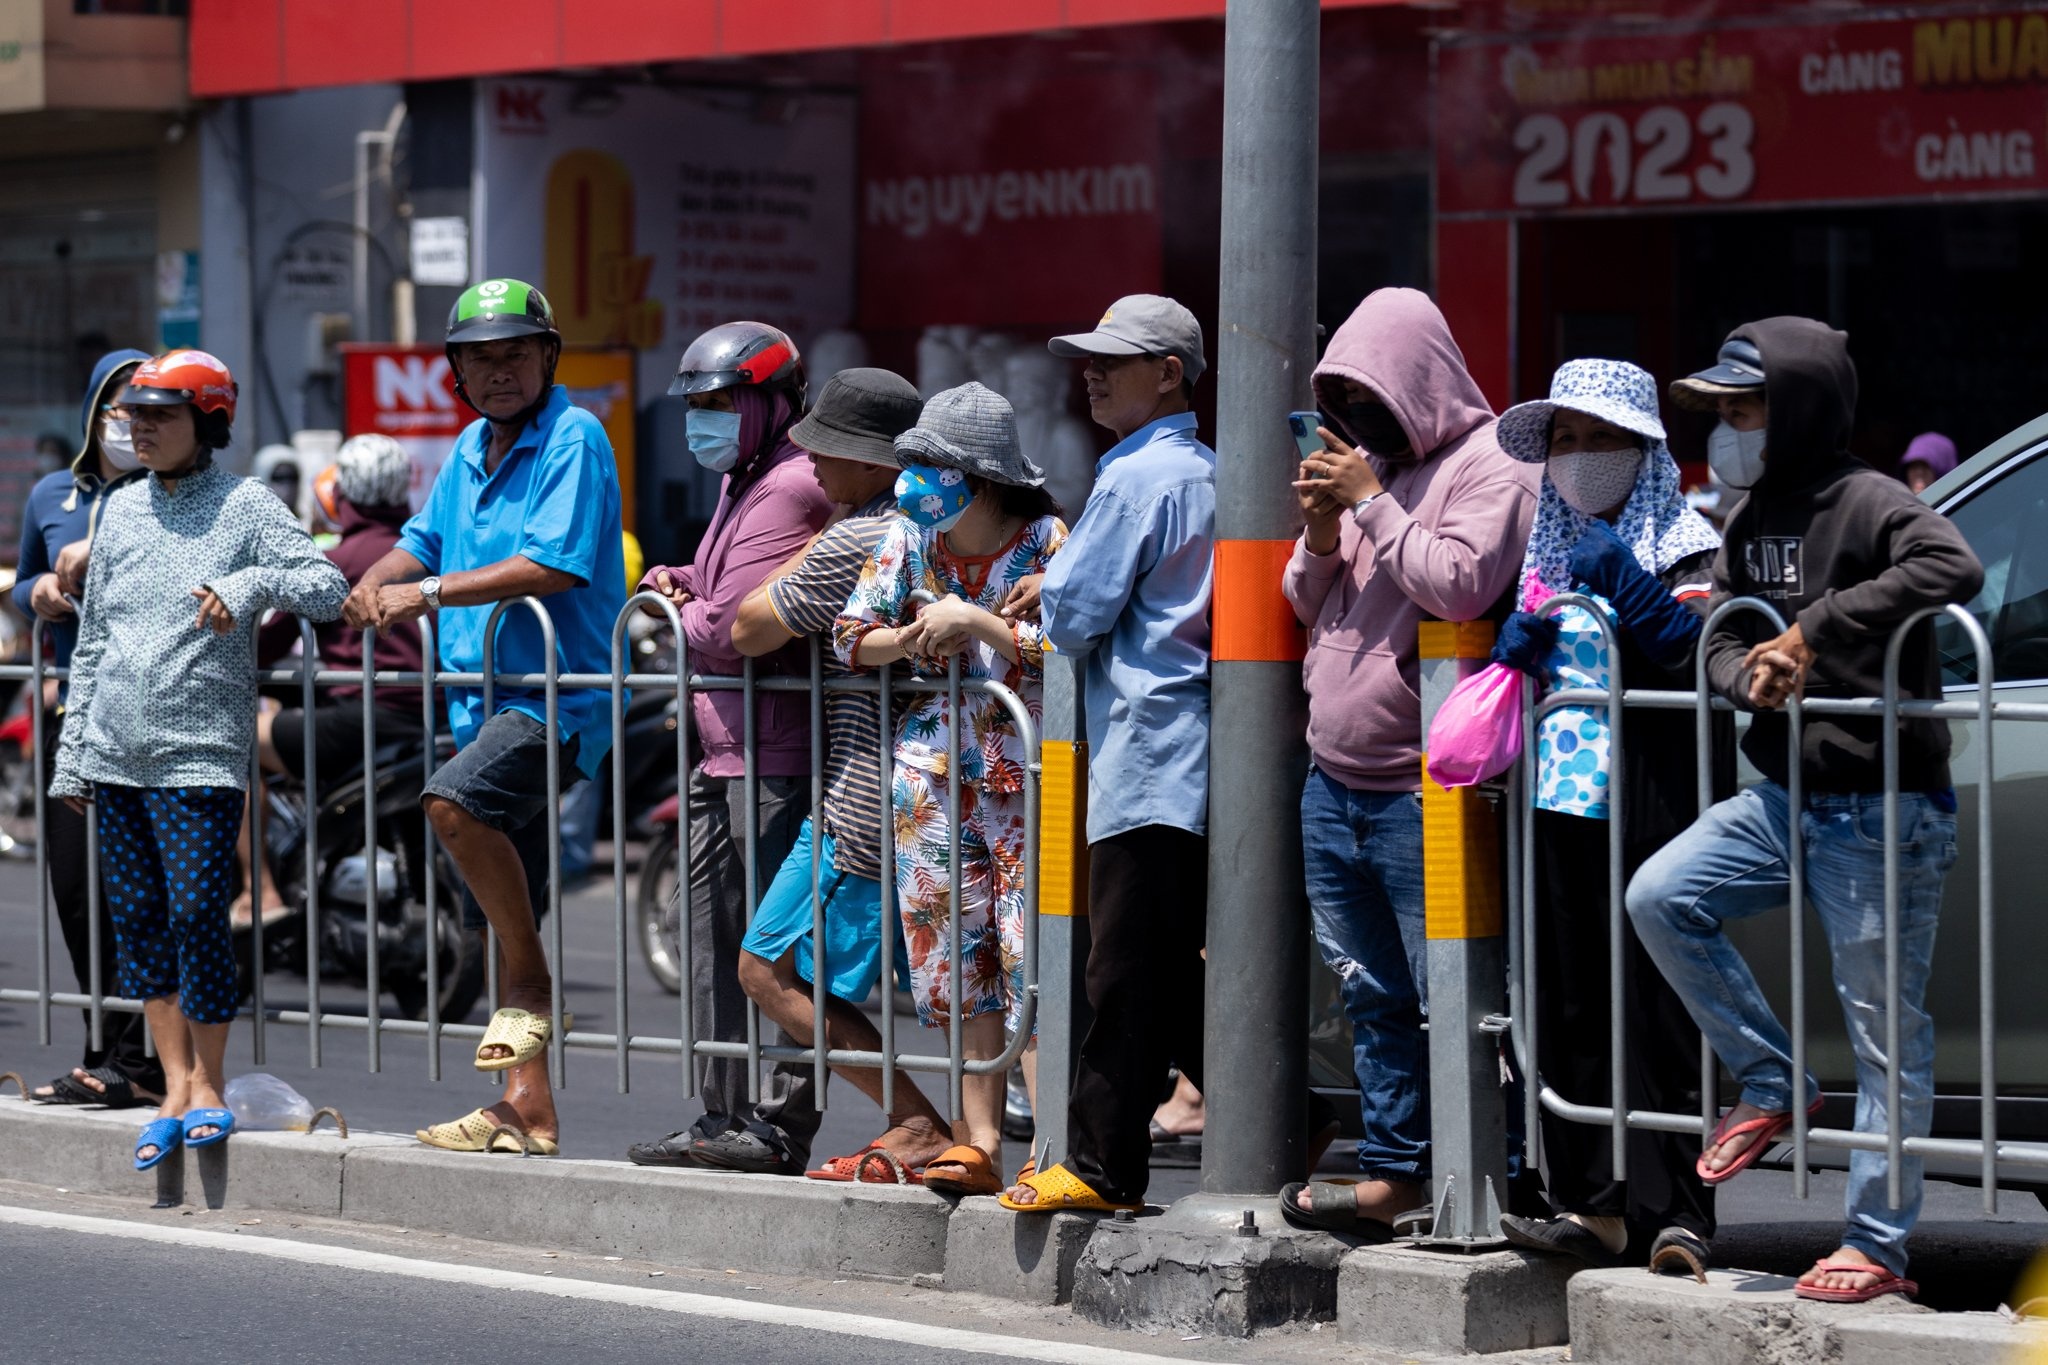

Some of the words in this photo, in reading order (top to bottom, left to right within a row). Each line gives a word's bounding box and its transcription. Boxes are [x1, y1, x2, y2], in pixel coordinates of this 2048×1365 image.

[1800, 39, 1903, 95] CÀNG
[1912, 15, 2048, 87] MUA
[1514, 102, 1755, 206] 2023
[1915, 117, 2035, 181] CÀNG
[373, 355, 457, 410] NK
